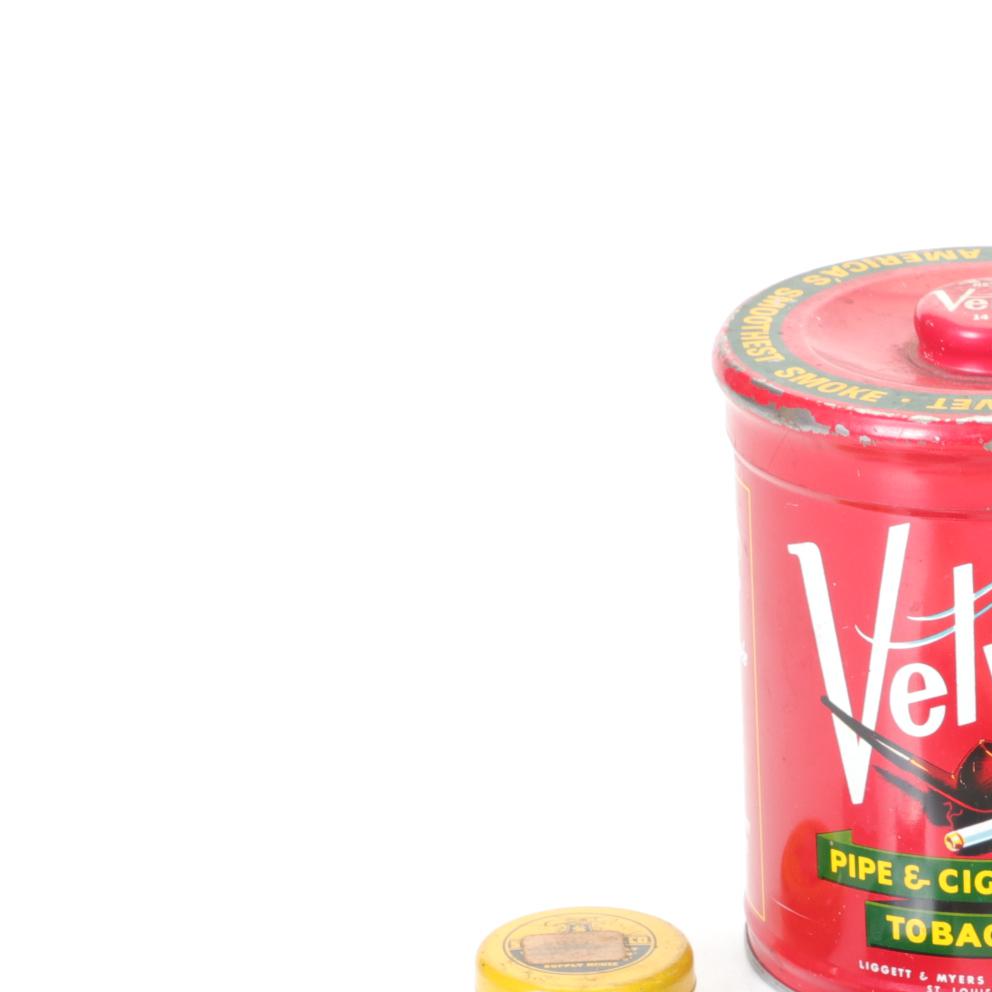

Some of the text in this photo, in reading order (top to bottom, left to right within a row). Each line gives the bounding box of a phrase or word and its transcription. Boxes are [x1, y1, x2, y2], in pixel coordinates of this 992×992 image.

[740, 249, 981, 402] AMERICA'S SMOOTHEST SMOKE
[830, 848, 894, 887] PIPE
[904, 863, 930, 889] &
[858, 960, 913, 978] LIGGETT
[919, 972, 928, 983] &
[937, 973, 985, 986] MYERS
